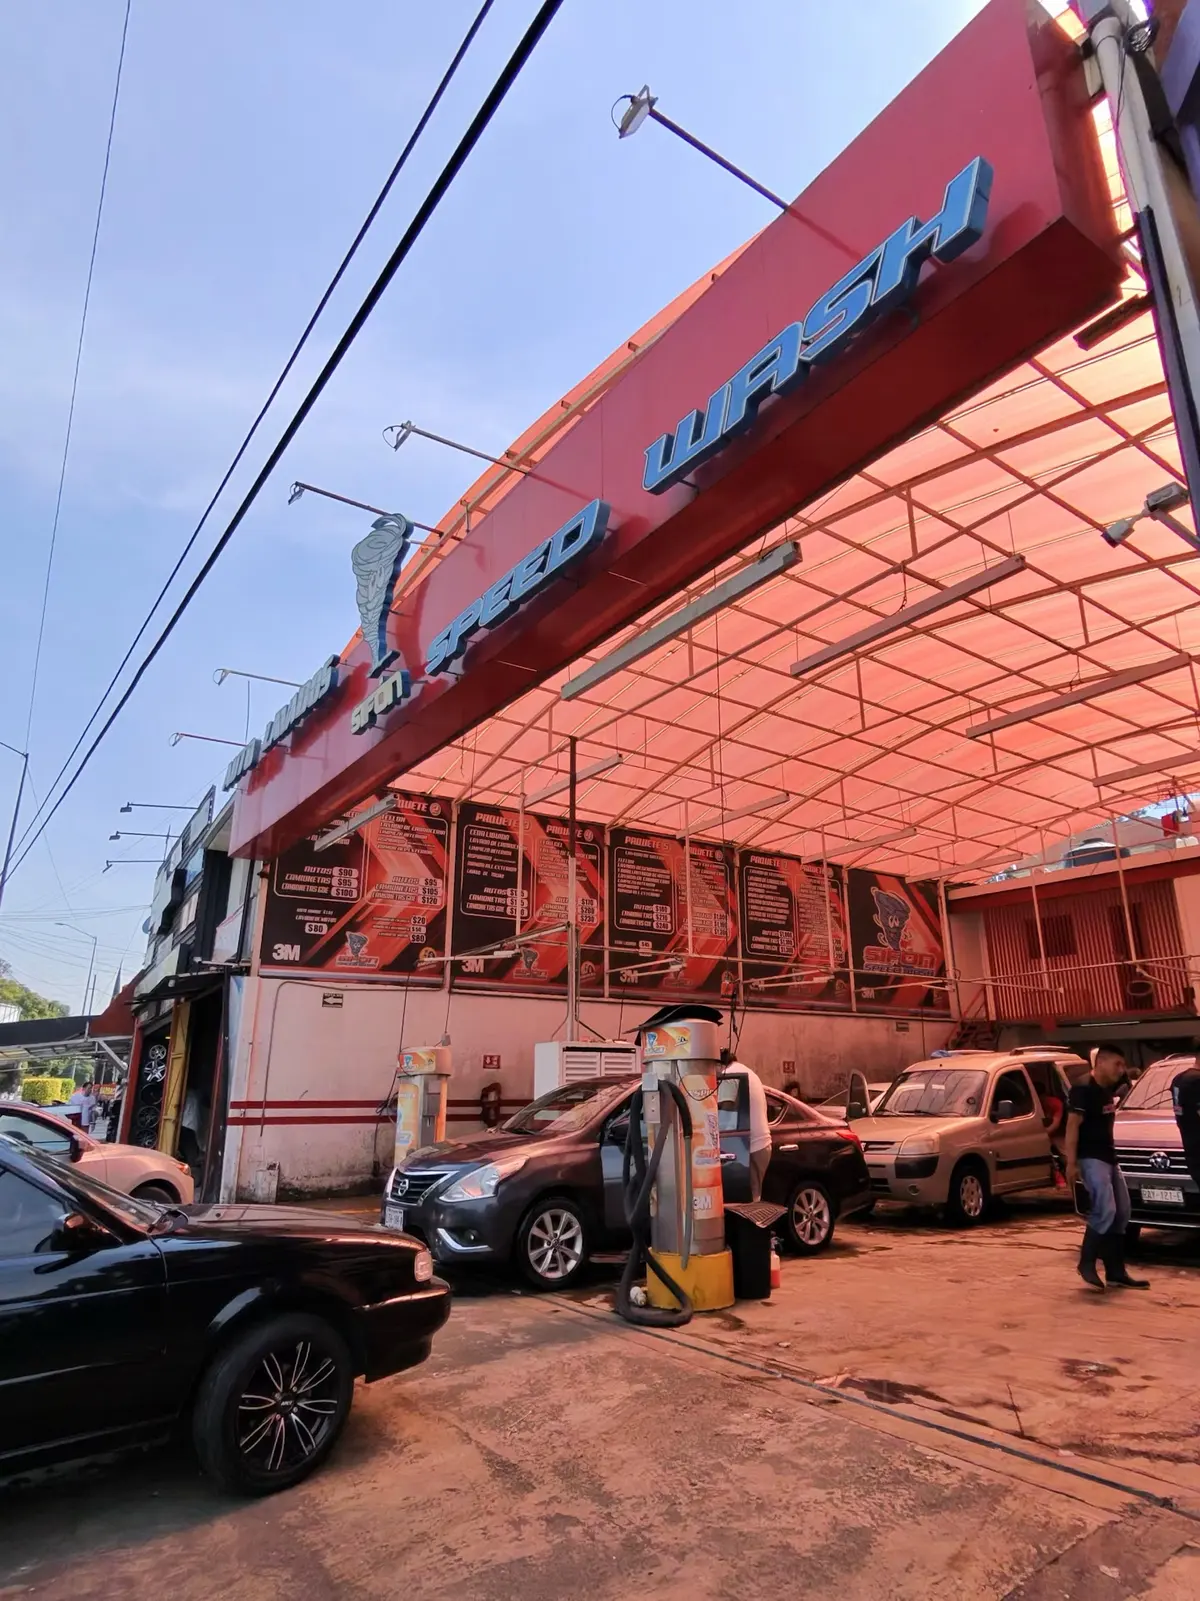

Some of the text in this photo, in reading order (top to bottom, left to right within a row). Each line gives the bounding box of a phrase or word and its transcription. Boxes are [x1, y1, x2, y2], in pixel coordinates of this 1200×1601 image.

[642, 156, 994, 494] WASH
[425, 498, 610, 678] SPEED
[396, 799, 429, 812] QUETE
[624, 836, 660, 849] PAQUETE
[338, 868, 353, 877] $90
[337, 878, 352, 887] $95
[424, 878, 437, 887] $95
[421, 896, 438, 905] $120
[412, 916, 426, 925] $20
[307, 923, 324, 933] $80
[272, 943, 300, 962] 3M
[461, 958, 484, 973] 3M
[692, 1196, 713, 1210] 3M
